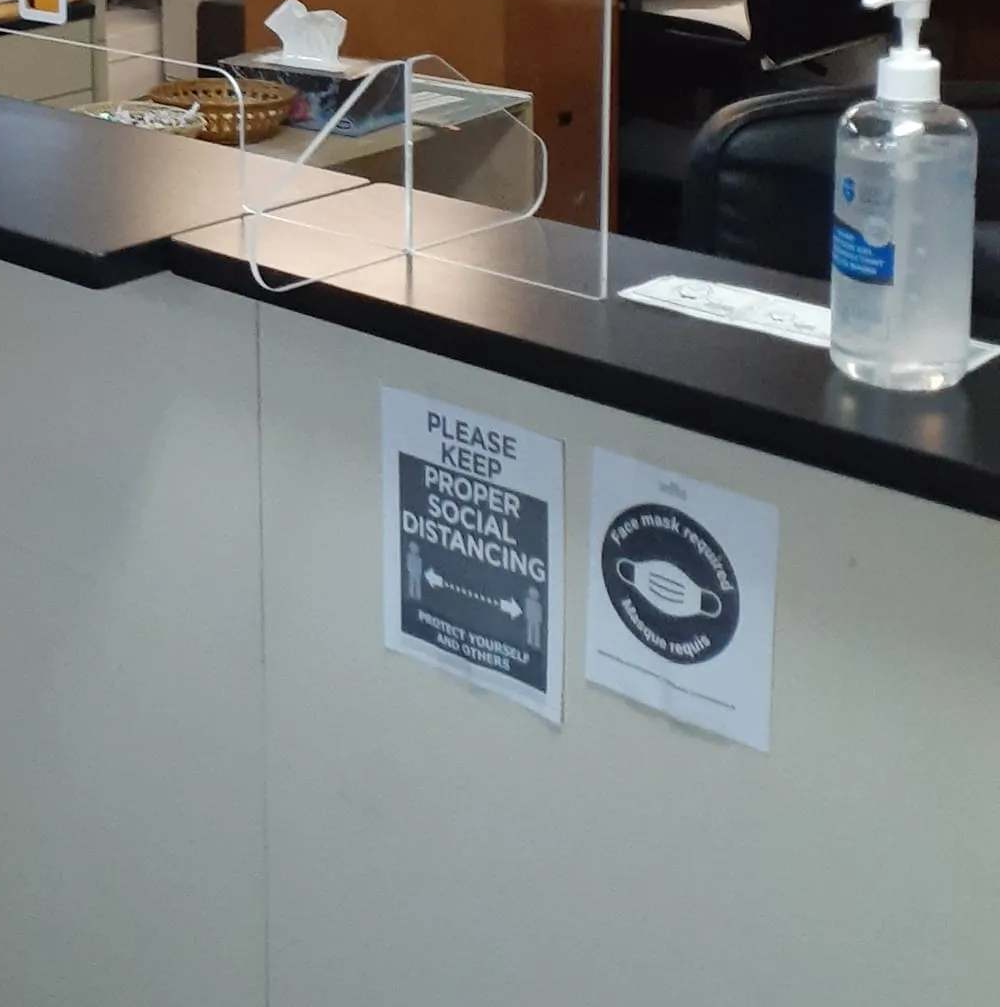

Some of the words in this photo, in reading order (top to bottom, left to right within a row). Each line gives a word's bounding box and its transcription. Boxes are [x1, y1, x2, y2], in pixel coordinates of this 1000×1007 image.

[427, 411, 517, 460] PLEASE
[441, 442, 502, 479] KEEP
[424, 465, 521, 518] PROPER
[402, 509, 546, 582] DISTANCING
[428, 494, 517, 545] SOCIAL
[610, 519, 640, 545] Face
[640, 514, 680, 534] mask
[683, 527, 734, 591] required
[418, 609, 466, 641] PROTECT
[468, 631, 530, 664] YOURSELF
[437, 632, 460, 650] AND
[461, 644, 511, 671] OTHERS
[622, 598, 668, 650] Masque
[669, 634, 711, 658] requis
